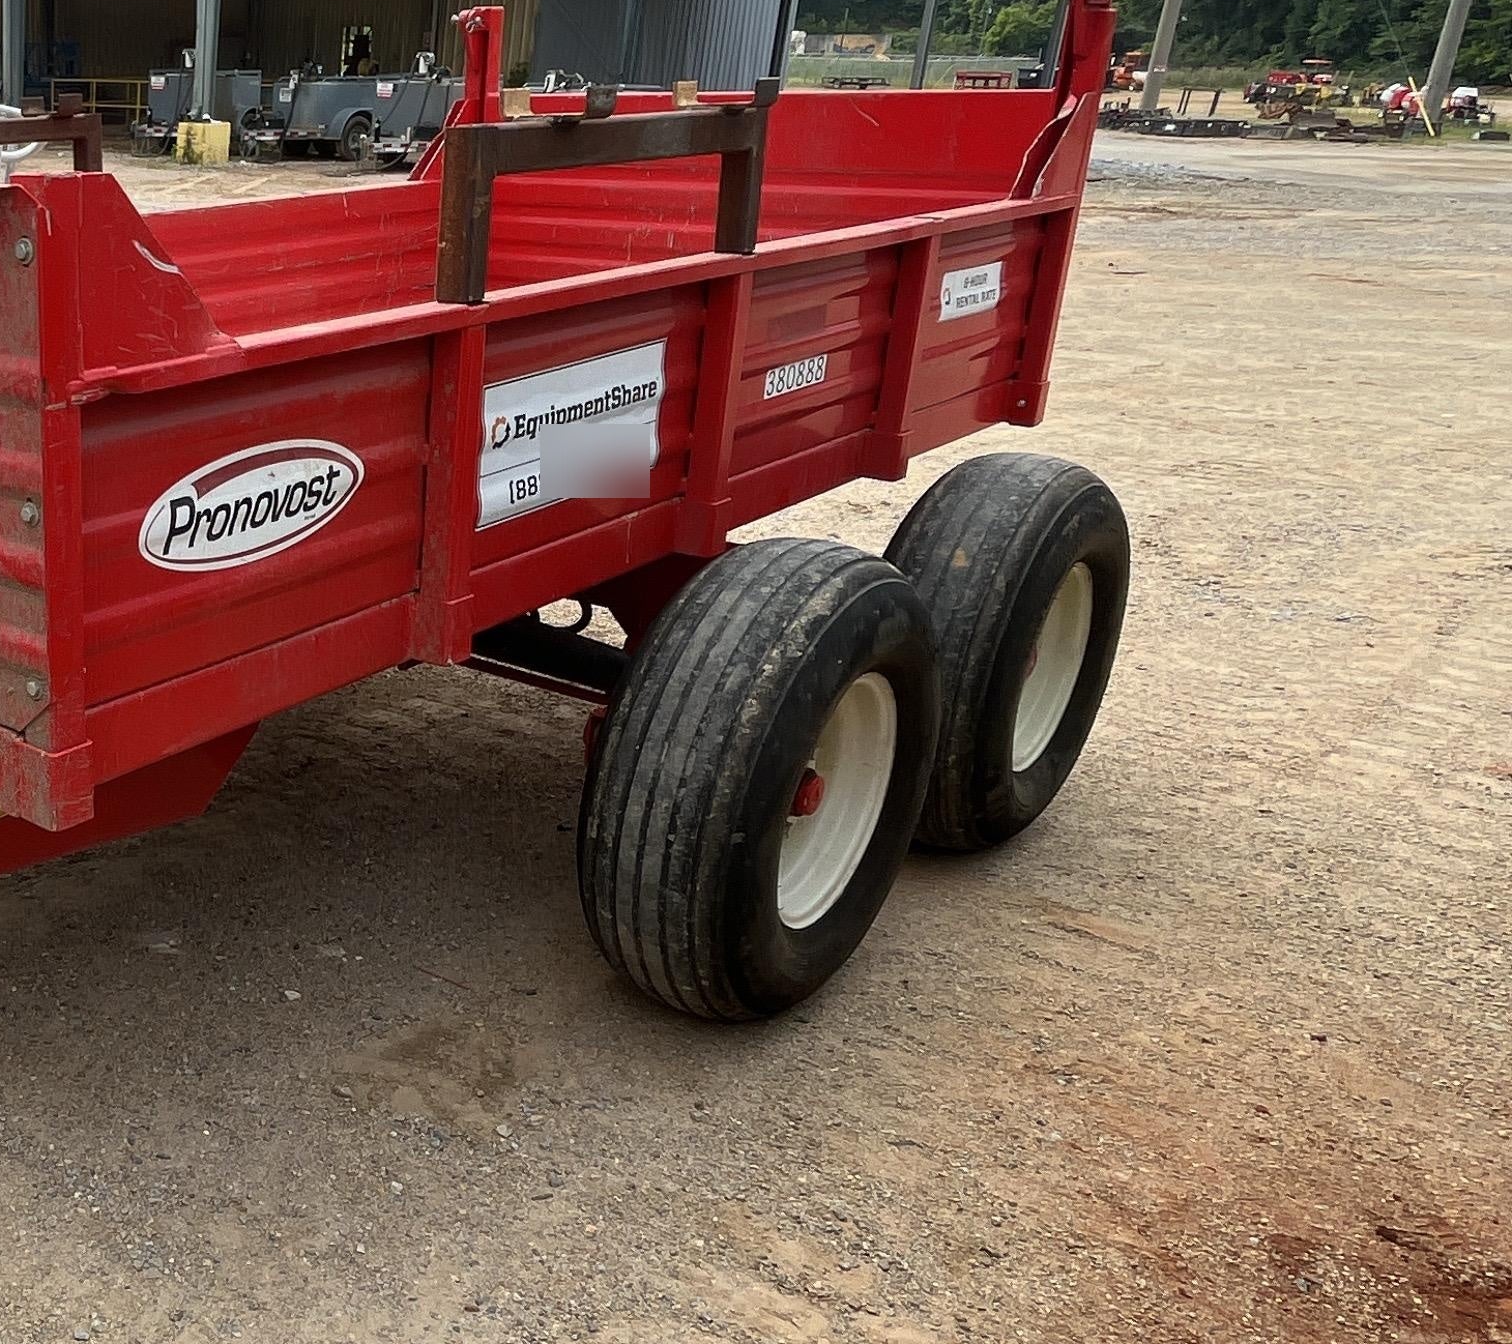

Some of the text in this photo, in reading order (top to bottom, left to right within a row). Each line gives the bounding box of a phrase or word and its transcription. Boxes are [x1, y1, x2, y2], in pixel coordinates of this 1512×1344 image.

[766, 356, 825, 396] 380888
[509, 474, 540, 505] (88
[162, 464, 341, 556] Pronovost
